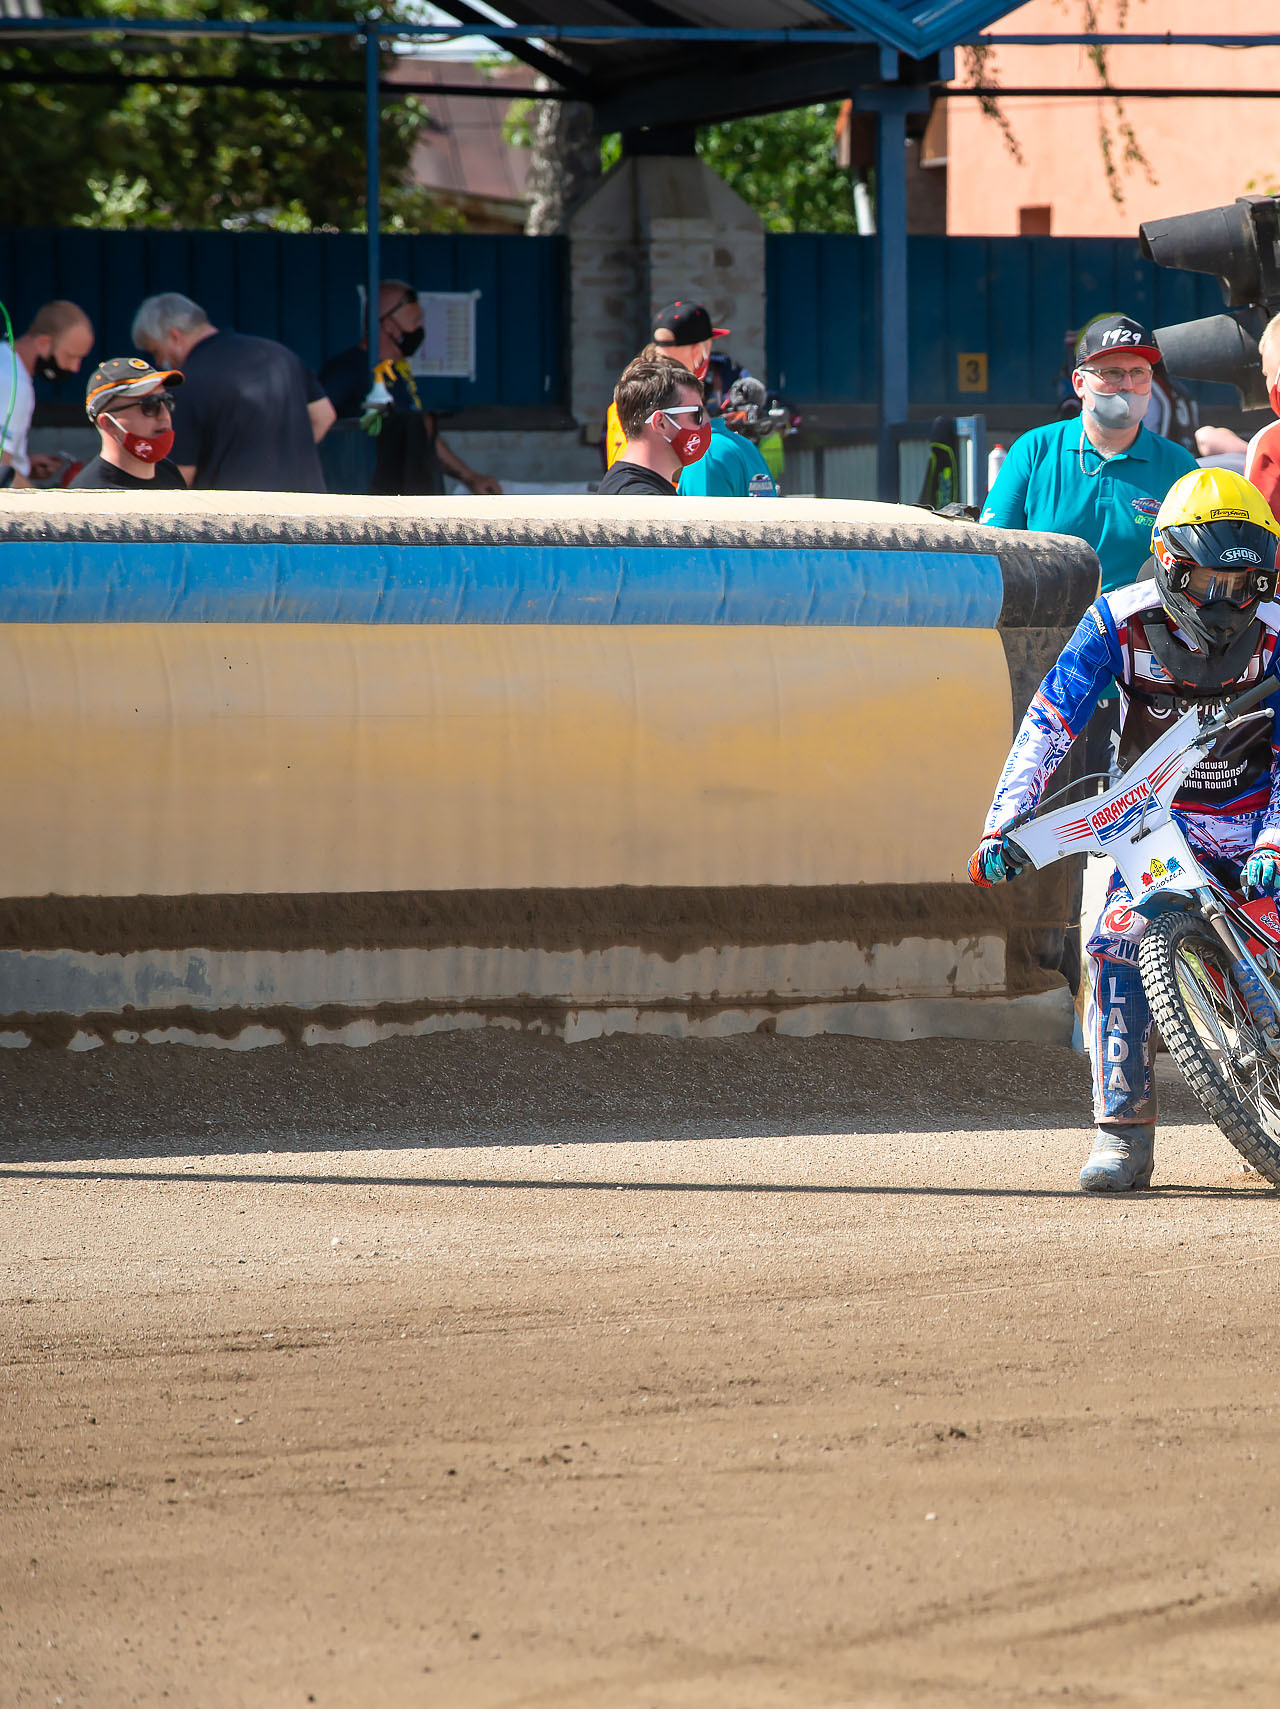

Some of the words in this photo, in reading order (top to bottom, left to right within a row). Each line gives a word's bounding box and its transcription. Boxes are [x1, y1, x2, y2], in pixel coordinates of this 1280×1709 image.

[1102, 328, 1141, 346] 1929
[966, 359, 980, 384] 3
[1226, 548, 1258, 561] SHOEI
[1205, 779, 1231, 789] Round
[1234, 777, 1239, 786] 1
[1092, 783, 1149, 830] ABRAMCZYK
[1107, 976, 1132, 1092] LADA
